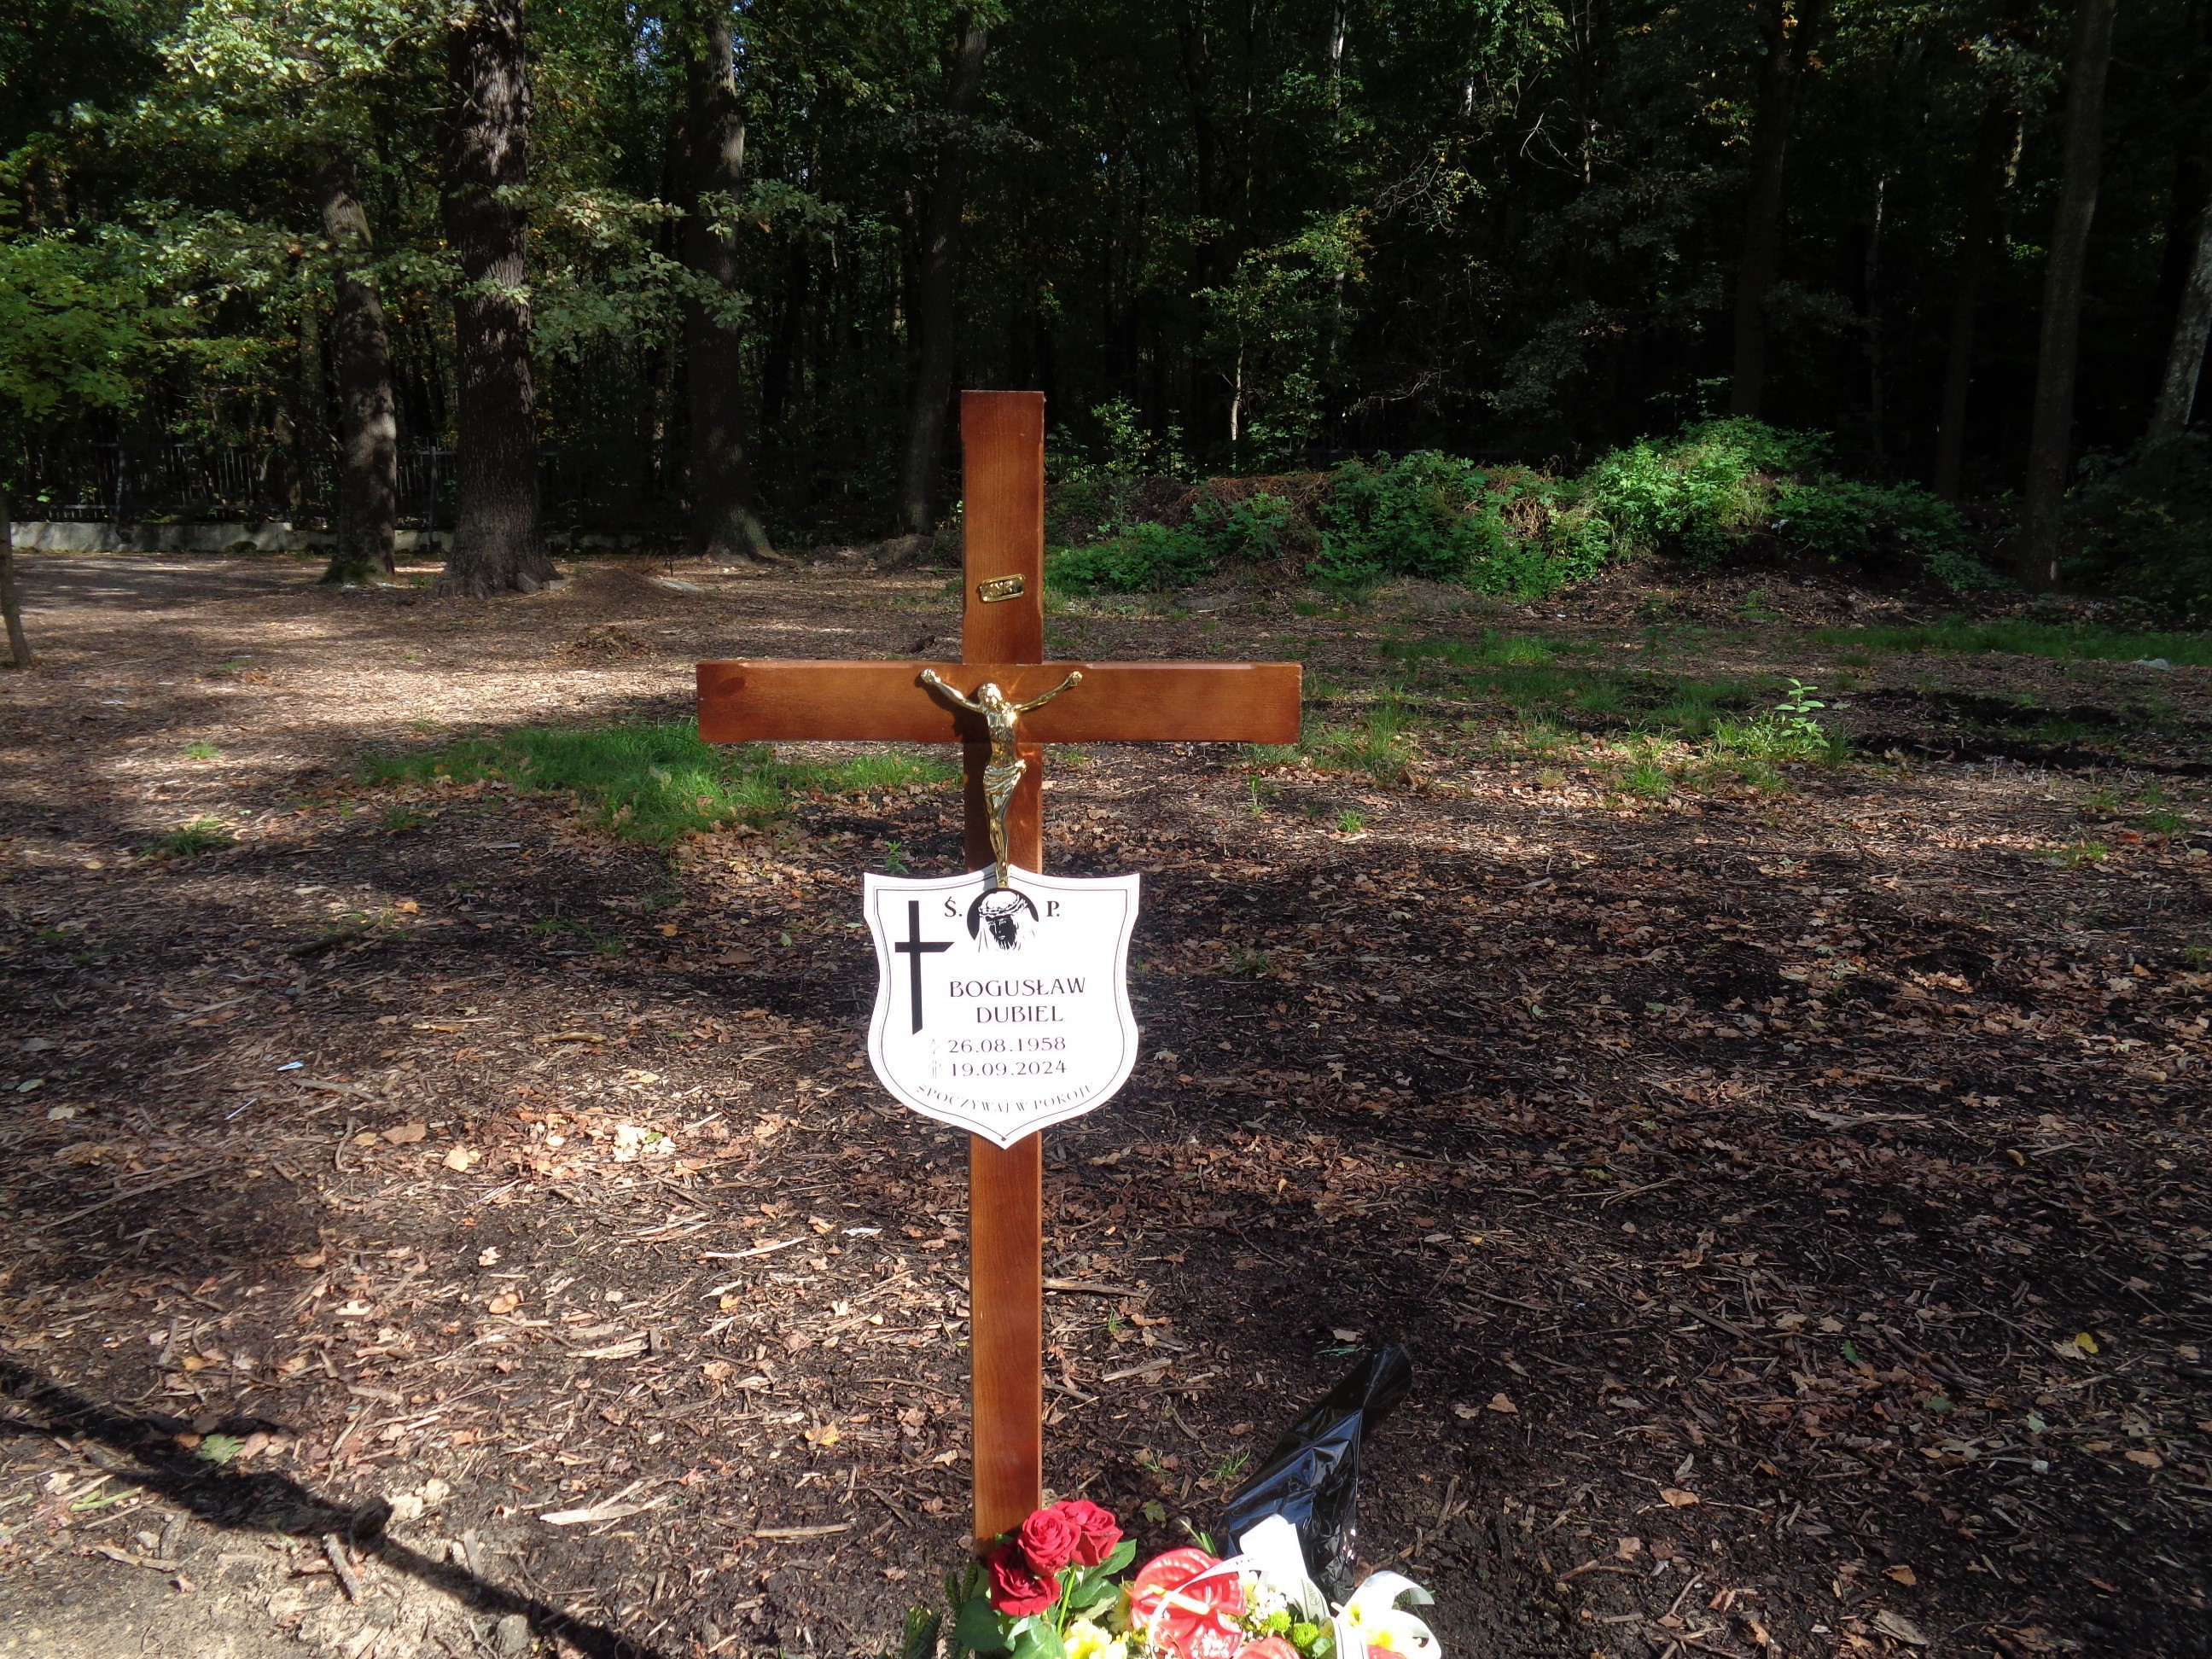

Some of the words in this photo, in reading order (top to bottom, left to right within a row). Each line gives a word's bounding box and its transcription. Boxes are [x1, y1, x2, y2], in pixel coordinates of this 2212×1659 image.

[945, 896, 963, 917] Ś.
[1046, 900, 1060, 917] P.
[950, 977, 1086, 998] BOGUSŁAW
[976, 1005, 1063, 1023] DUBIEL
[948, 1037, 1066, 1053] 26.08.1958
[952, 1060, 1067, 1076] 19.09.2024
